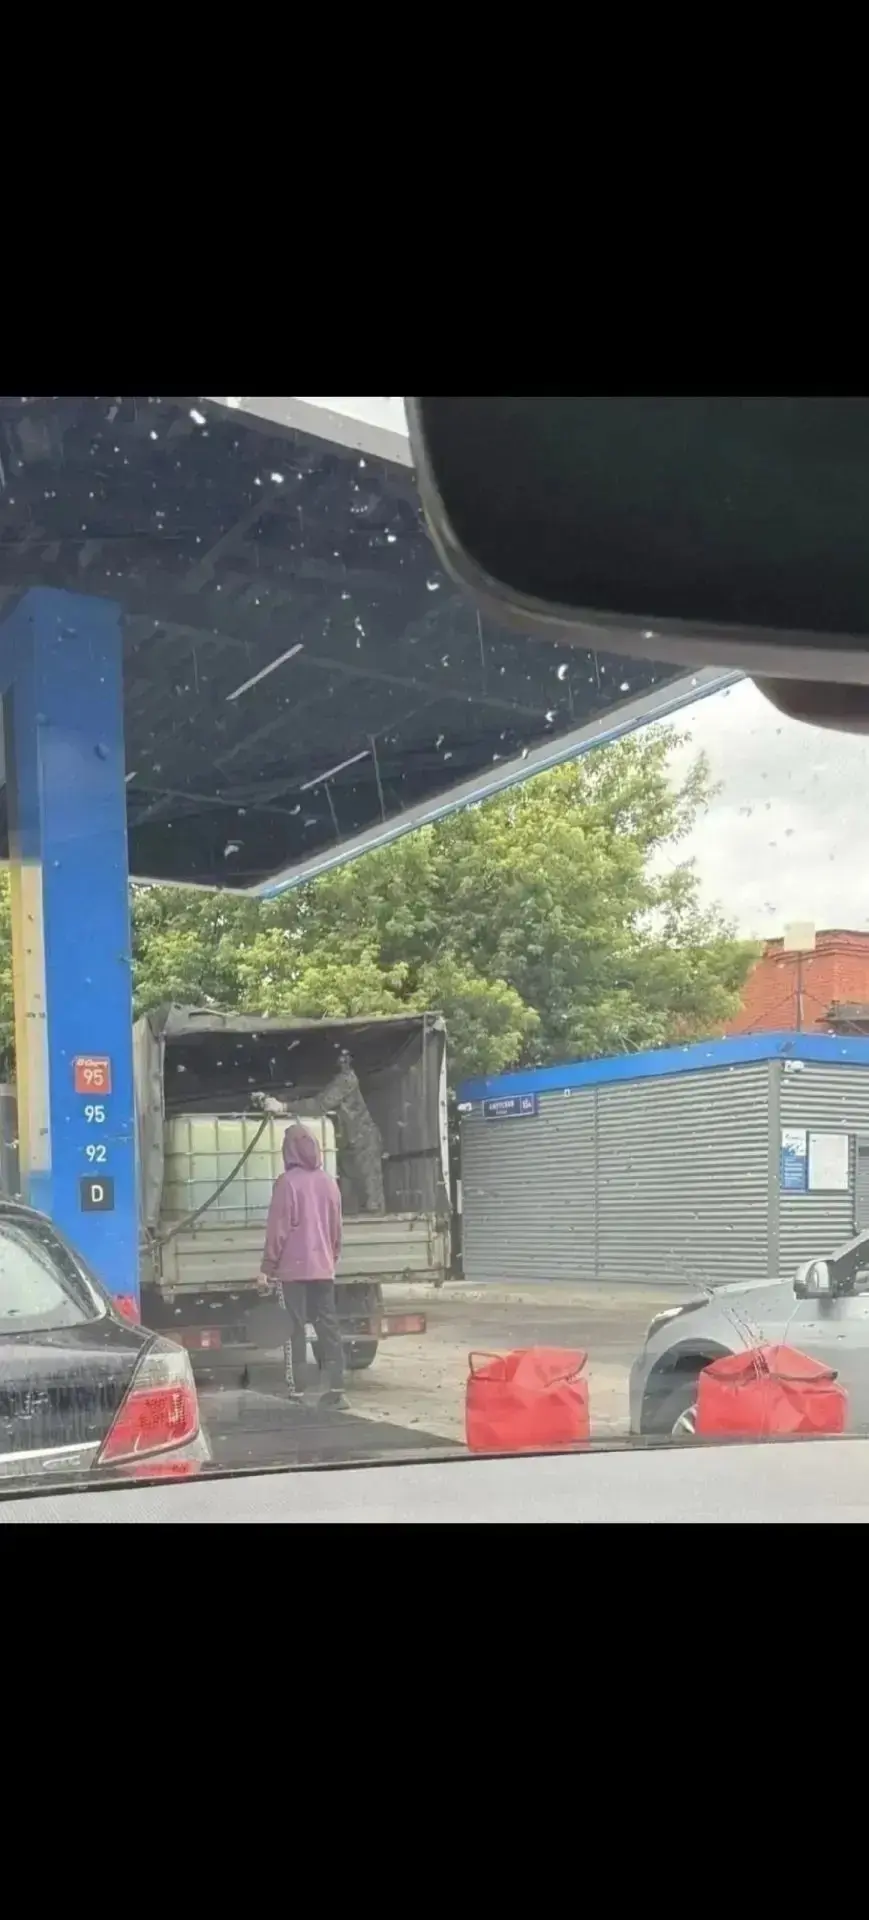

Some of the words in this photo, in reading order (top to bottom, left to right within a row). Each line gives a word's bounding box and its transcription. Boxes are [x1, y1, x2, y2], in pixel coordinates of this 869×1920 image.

[83, 1069, 104, 1086] 95
[84, 1105, 105, 1123] 95
[86, 1144, 107, 1162] 92
[91, 1184, 104, 1202] D
